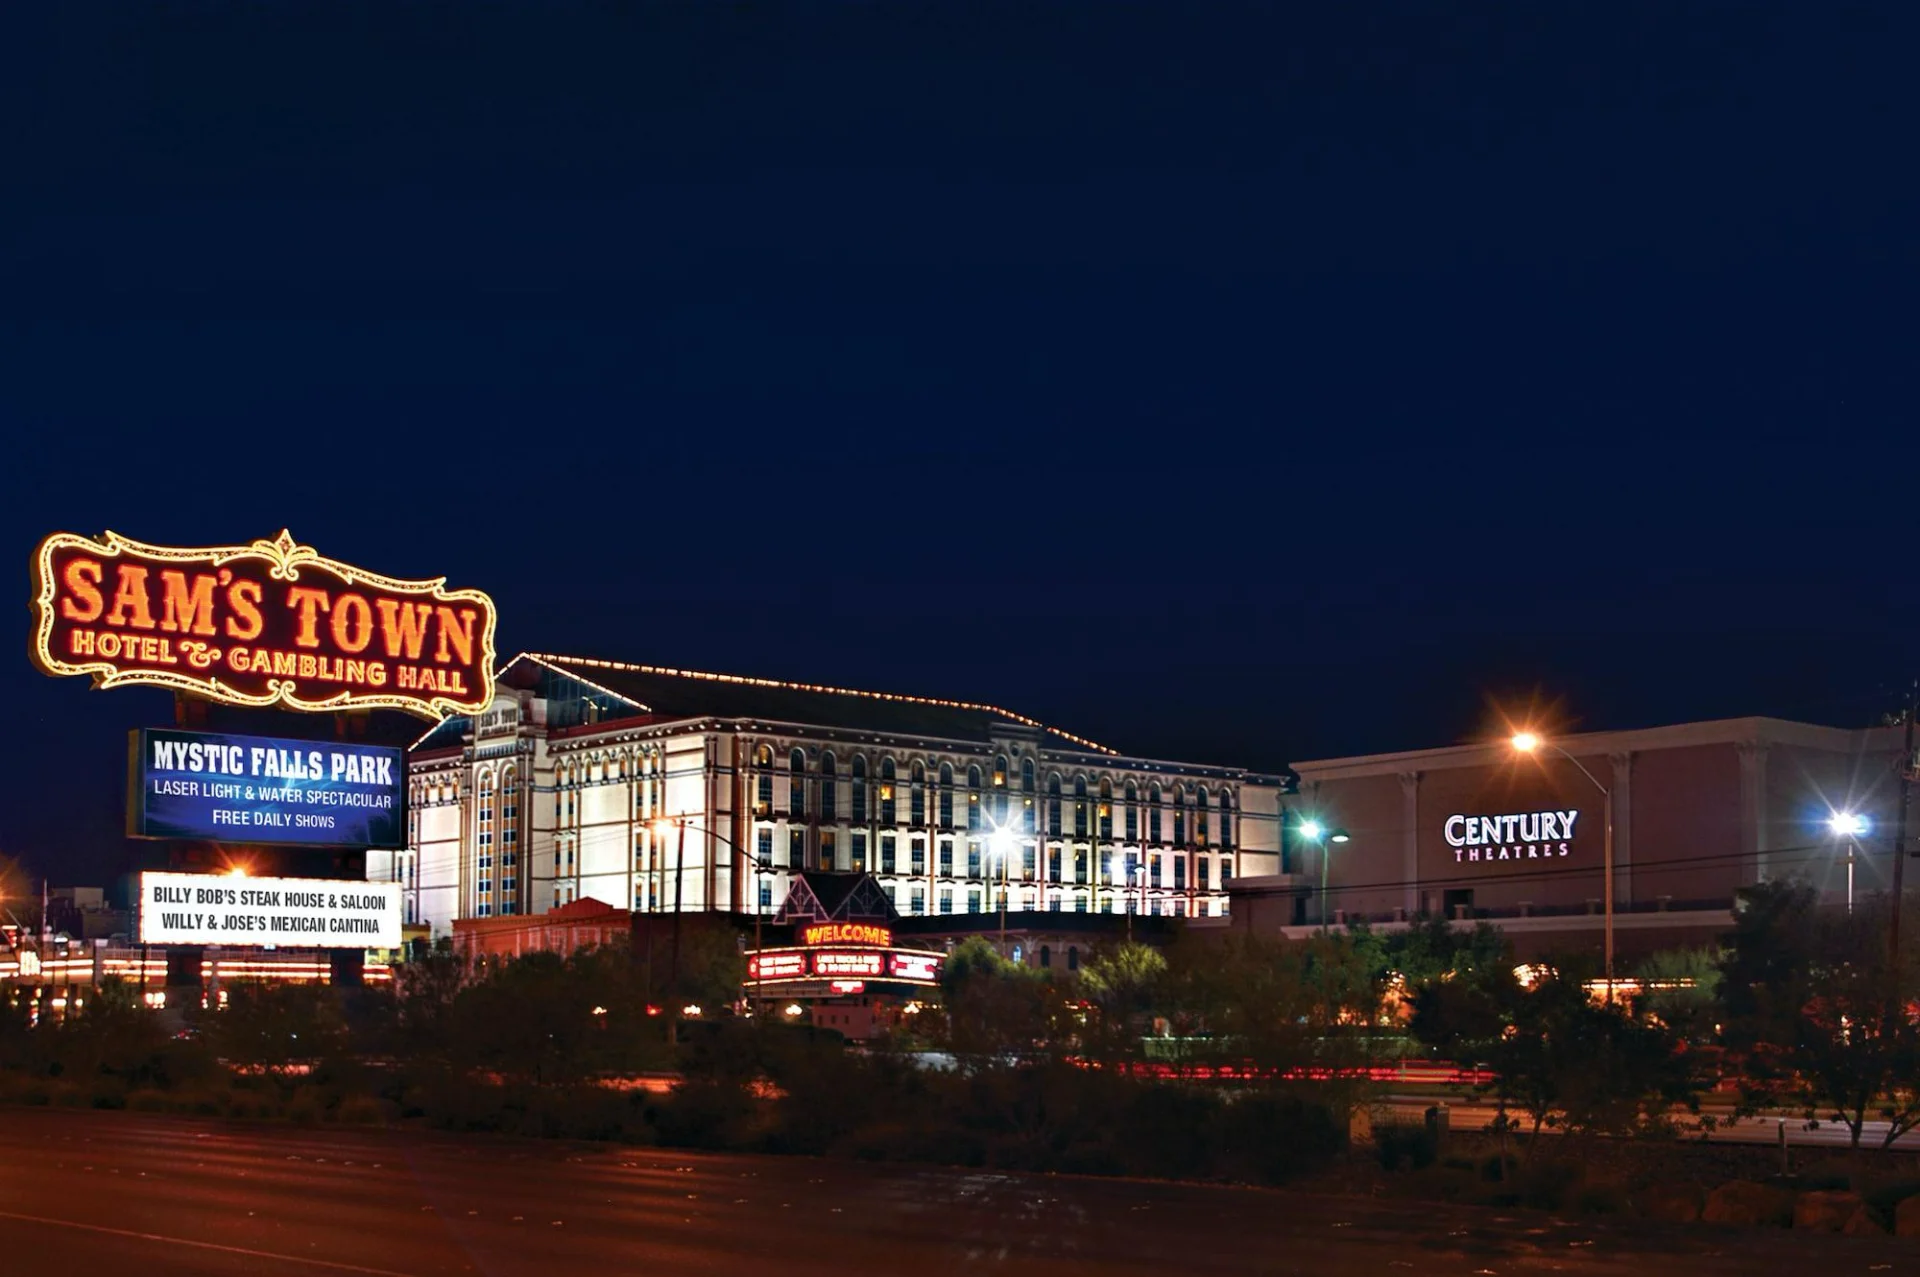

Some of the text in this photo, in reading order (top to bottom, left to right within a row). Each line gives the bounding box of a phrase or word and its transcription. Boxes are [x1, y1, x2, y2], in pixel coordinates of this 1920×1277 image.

[63, 558, 477, 666] SAM'S TOWN
[71, 629, 468, 694] HOTEL & GAMBLING HALL
[153, 740, 393, 786] MYSTIC FALLS PARK
[154, 779, 392, 809] LASER LIGHT & WATER SPECTACULAR
[212, 809, 335, 829] FREE DAILY SHOWS
[1444, 810, 1578, 847] CENTURY
[1455, 843, 1568, 862] THEATRES
[153, 886, 386, 911] BILLY BOB'S STEAK HOUSE & SALOON
[161, 913, 380, 934] WILLY & JOSE'S MEXICAN CANTINA
[805, 924, 890, 945] WELCOME
